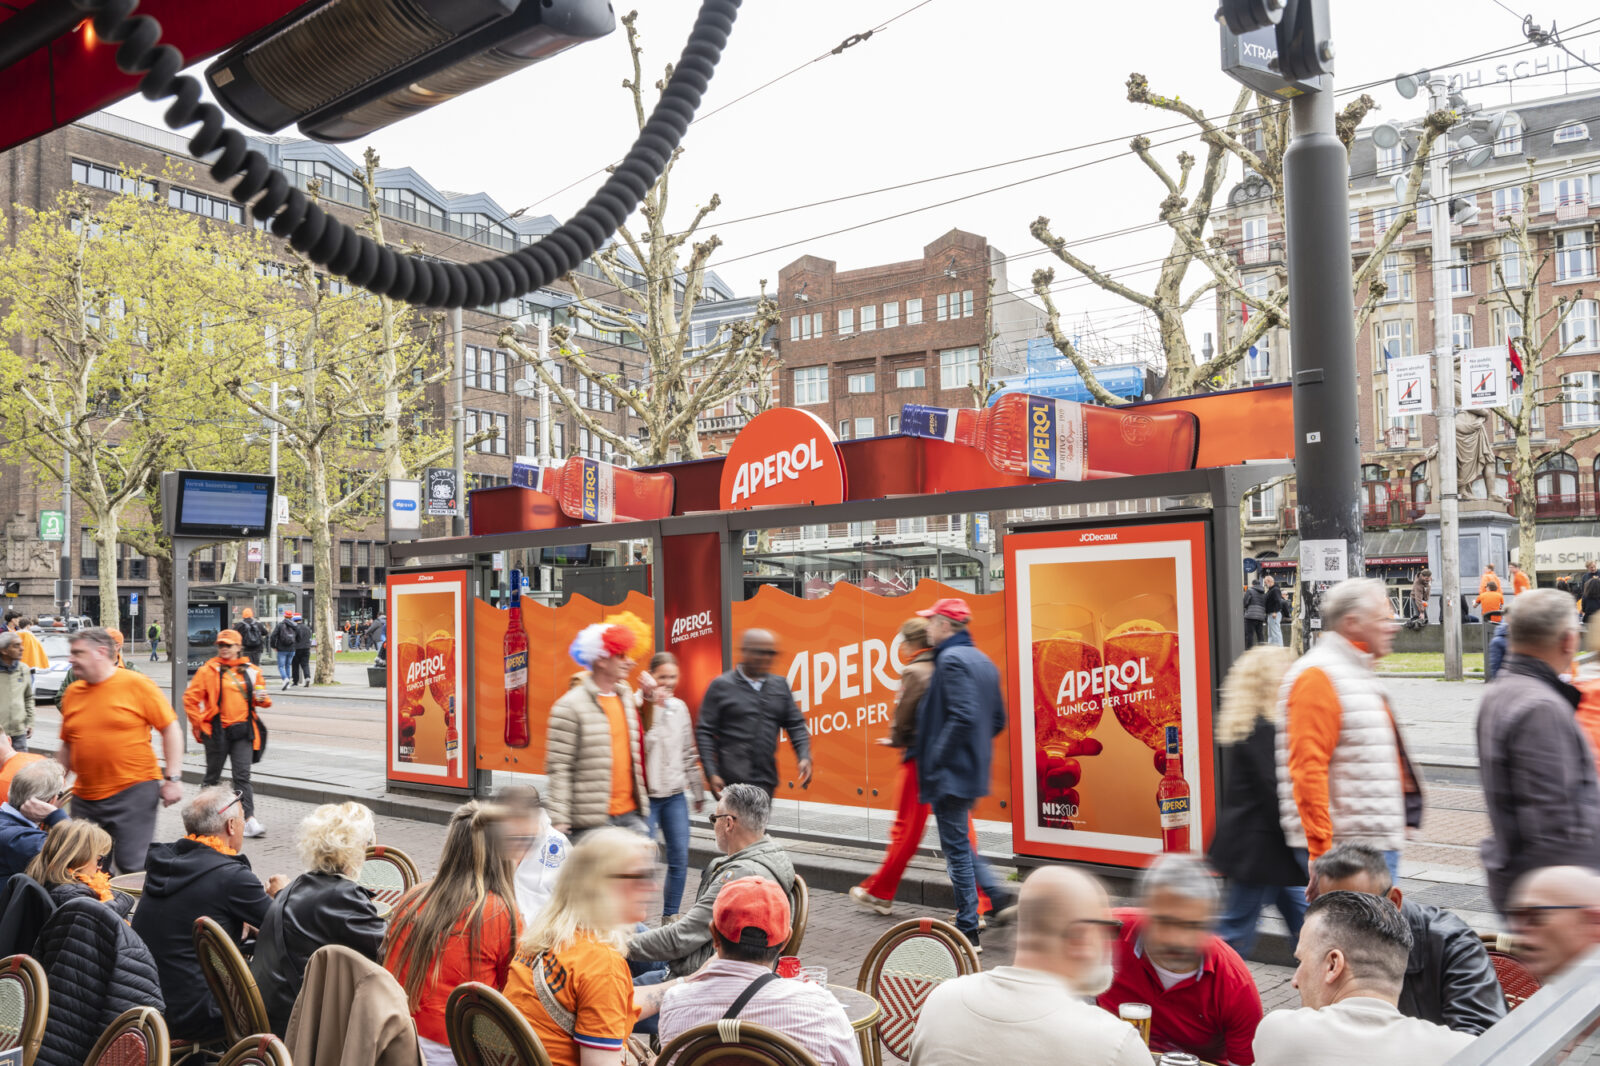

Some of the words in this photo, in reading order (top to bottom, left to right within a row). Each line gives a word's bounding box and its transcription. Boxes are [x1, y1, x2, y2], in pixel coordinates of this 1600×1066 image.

[1496, 47, 1600, 83] SCHILL
[1032, 404, 1051, 474] APEROL
[730, 438, 823, 504] APEROL
[584, 466, 596, 518] APEROL
[1079, 533, 1118, 542] JCDecaux
[671, 610, 713, 637] APEROL
[406, 653, 446, 684] APEROL
[786, 632, 906, 713] APERO
[1057, 657, 1154, 704] APEROL
[1057, 700, 1100, 717] L'UNICO.
[1101, 696, 1121, 709] PER
[1123, 689, 1156, 705] TUTTI.
[780, 711, 852, 743] LNICO.
[857, 702, 890, 727] PER
[1161, 801, 1188, 812] APEROL
